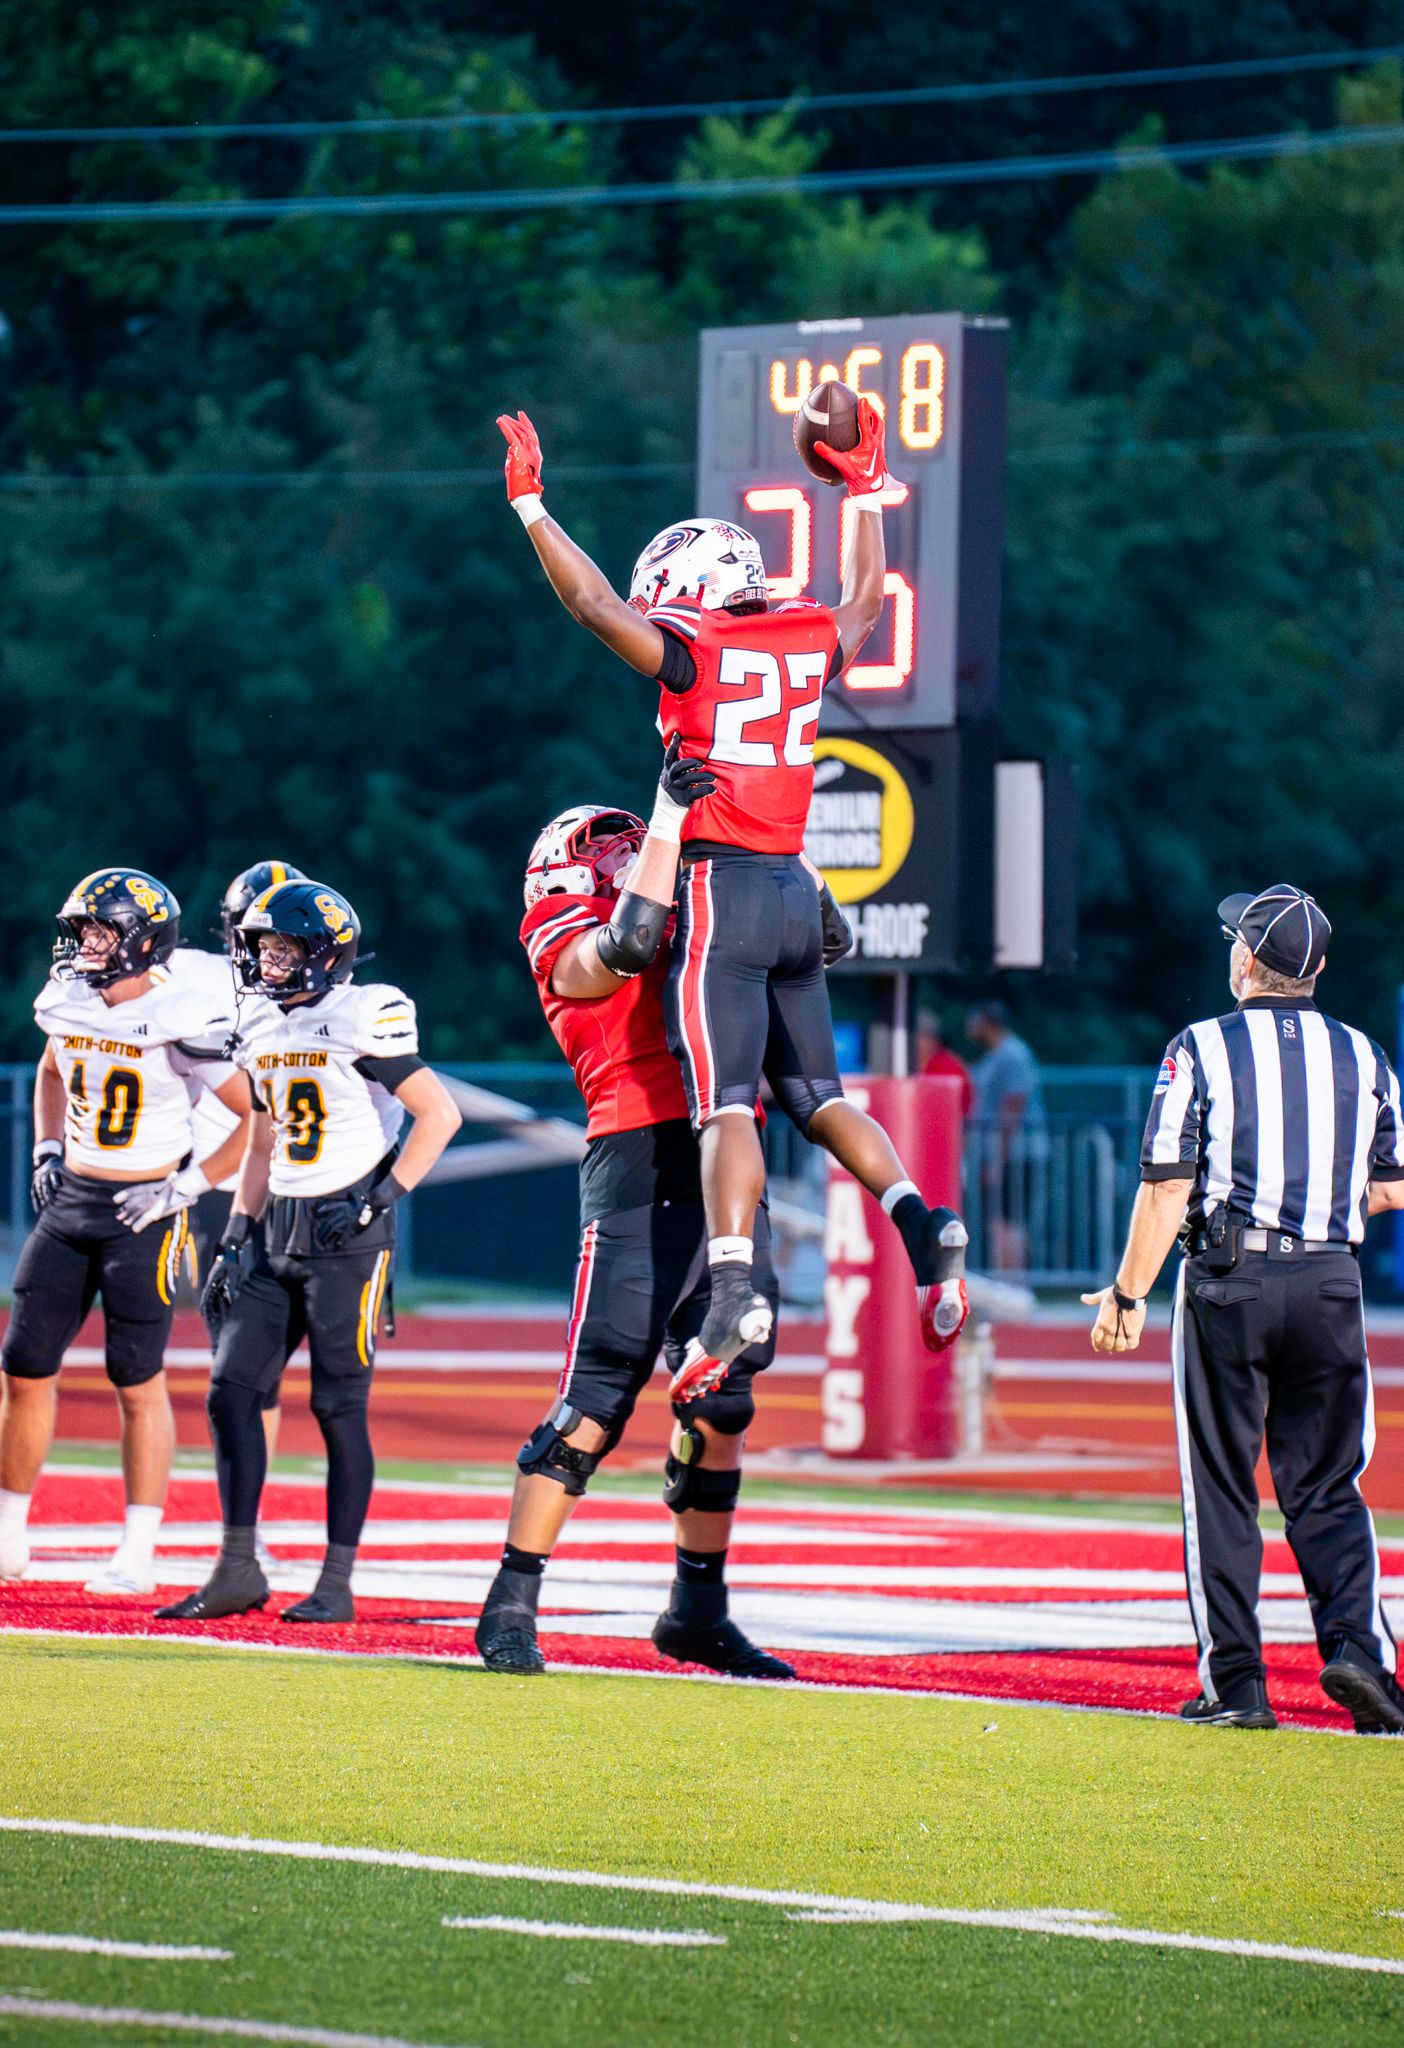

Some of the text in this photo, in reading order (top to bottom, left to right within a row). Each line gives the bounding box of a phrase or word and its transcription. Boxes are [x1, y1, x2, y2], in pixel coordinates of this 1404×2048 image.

[707, 647, 827, 767] 22
[63, 1035, 143, 1058] SMITH-COTTON
[821, 1086, 876, 1453] AYS
